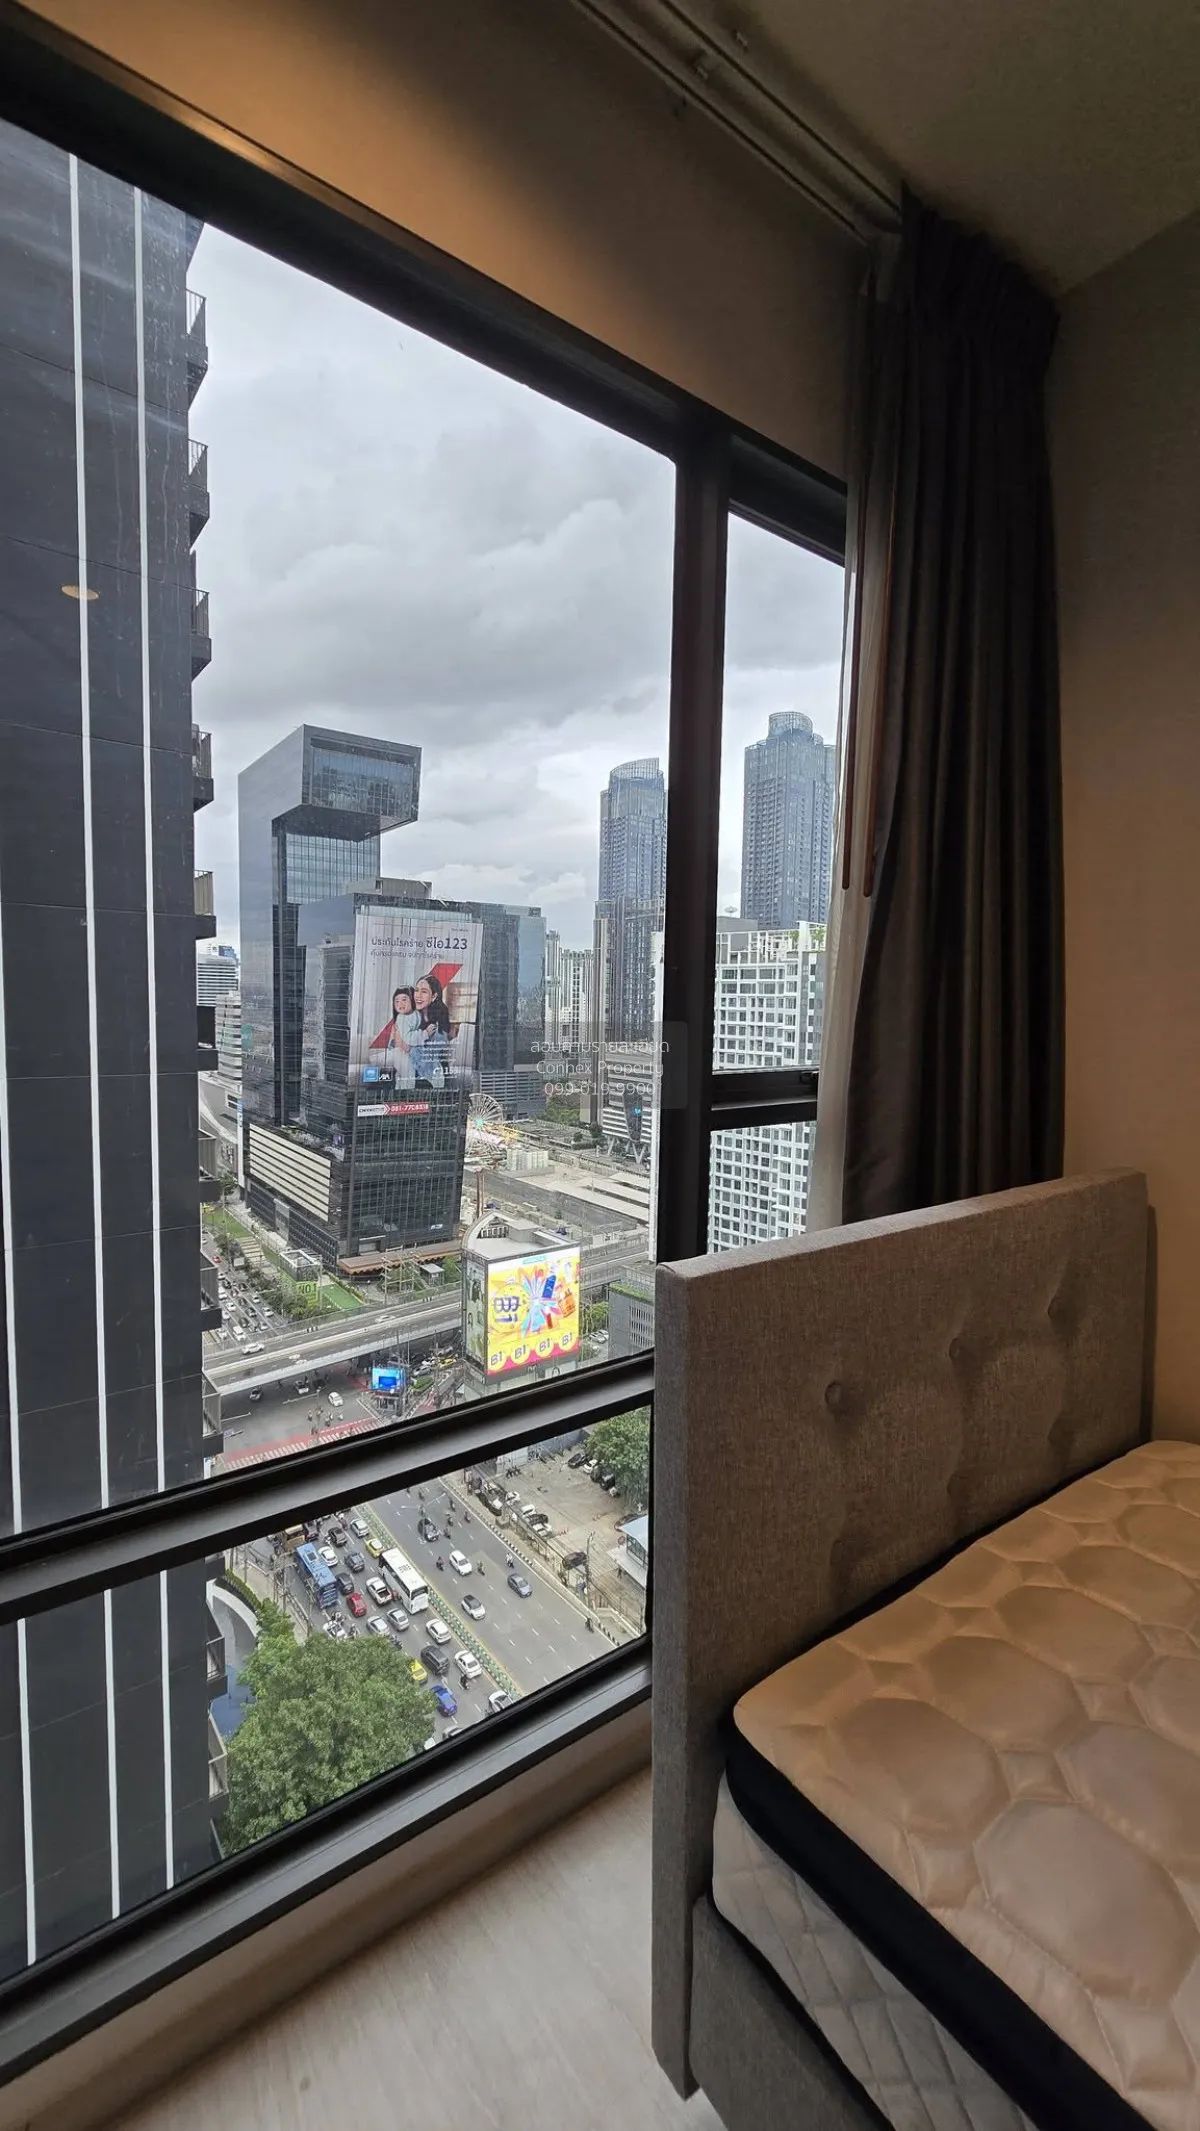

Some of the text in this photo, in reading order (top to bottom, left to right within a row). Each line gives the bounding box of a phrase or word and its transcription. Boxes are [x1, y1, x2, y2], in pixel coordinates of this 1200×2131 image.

[371, 937, 424, 948] ประกันโรคร้าย
